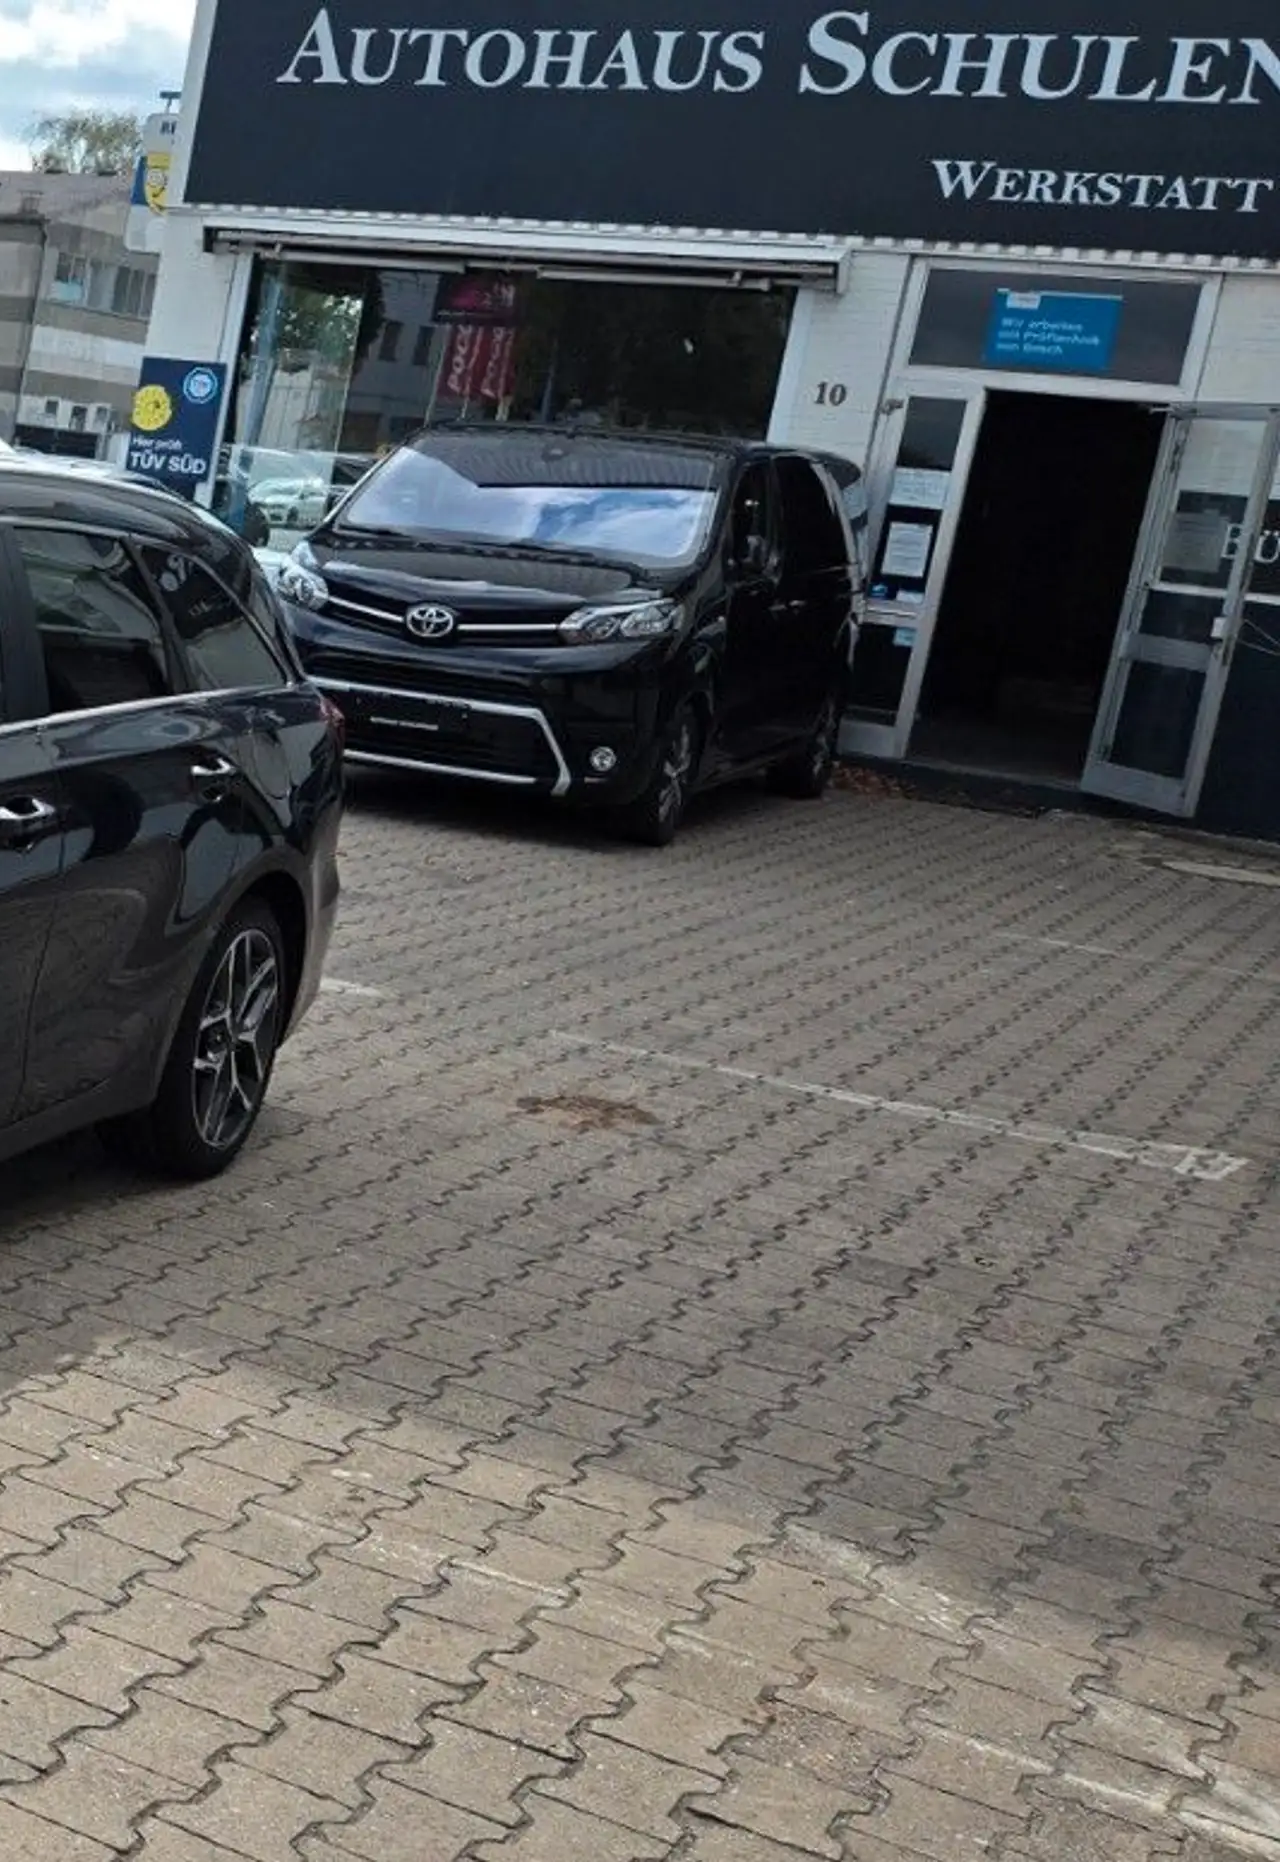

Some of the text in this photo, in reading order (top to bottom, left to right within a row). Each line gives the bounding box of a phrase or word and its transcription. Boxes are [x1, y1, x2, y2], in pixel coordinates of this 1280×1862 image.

[276, 7, 766, 93] AUTOHAUS
[932, 159, 1274, 213] WERKSTATT
[814, 381, 847, 406] 10
[130, 449, 207, 474] TÜV SÜD
